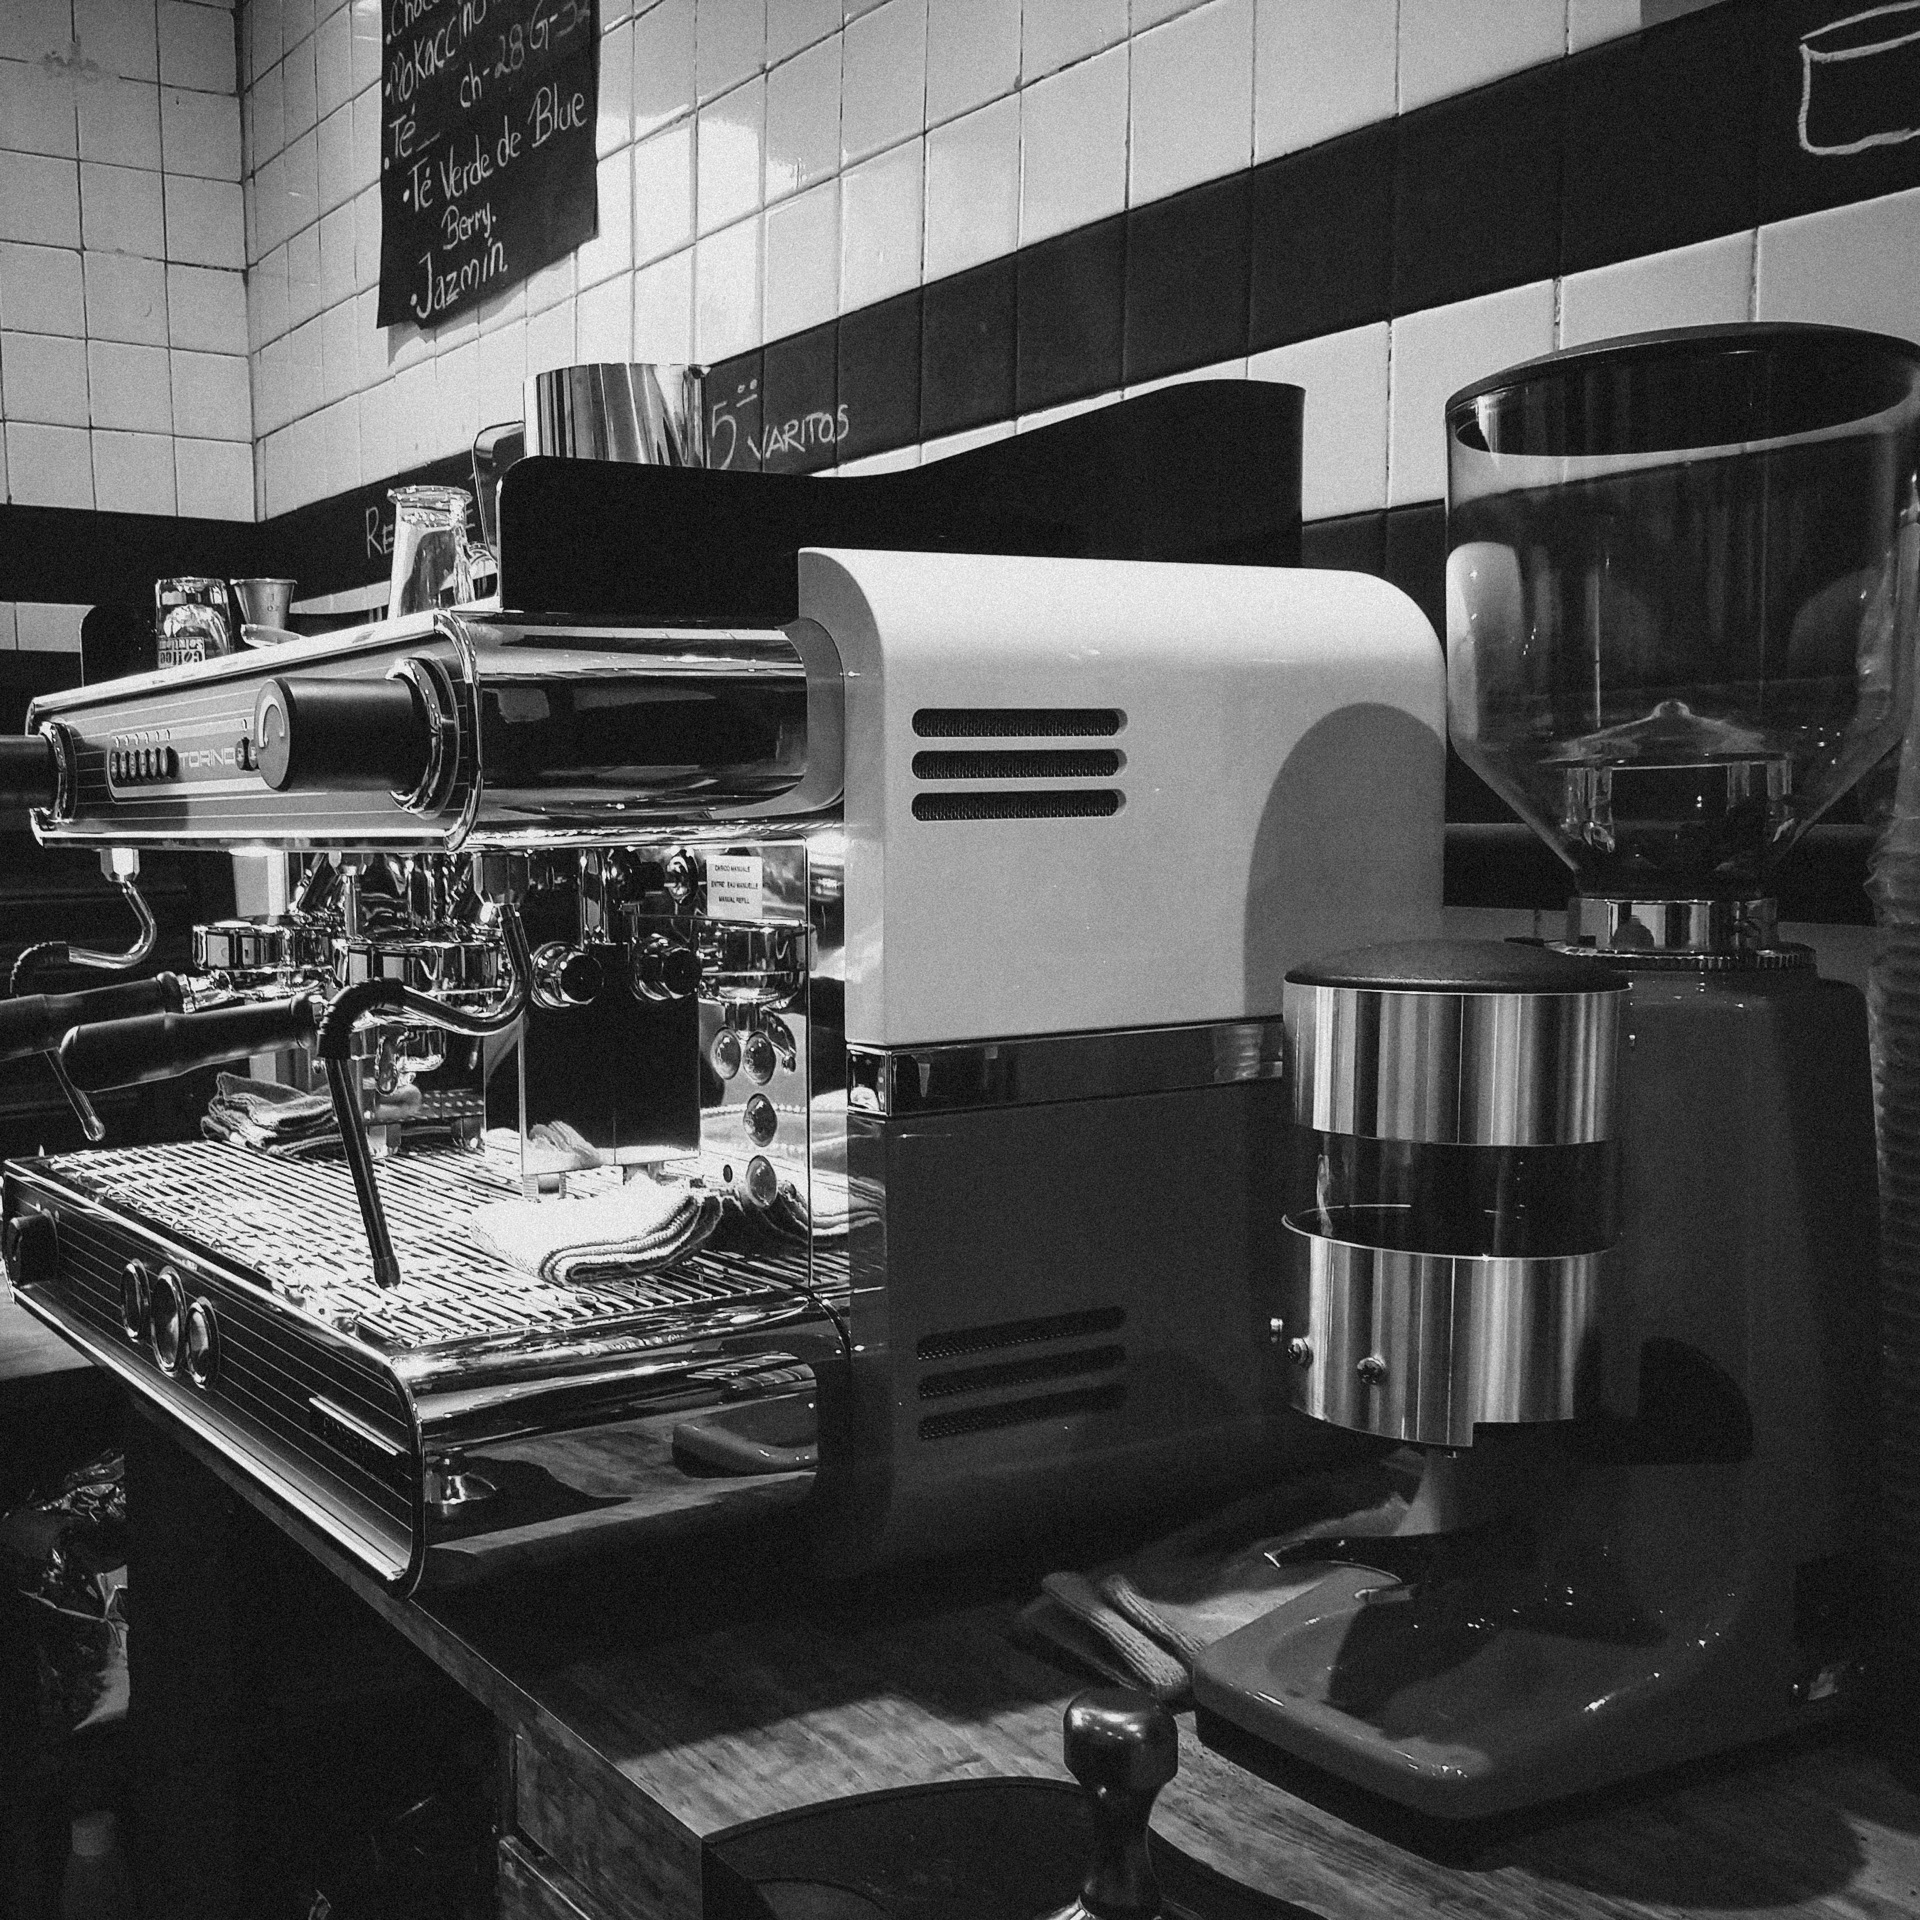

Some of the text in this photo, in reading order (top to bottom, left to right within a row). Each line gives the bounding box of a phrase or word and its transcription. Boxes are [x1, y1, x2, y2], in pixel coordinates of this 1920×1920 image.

[407, 83, 588, 213] Té Verde de Blue
[747, 403, 849, 459] VARITOS
[177, 747, 236, 770] TORINO
